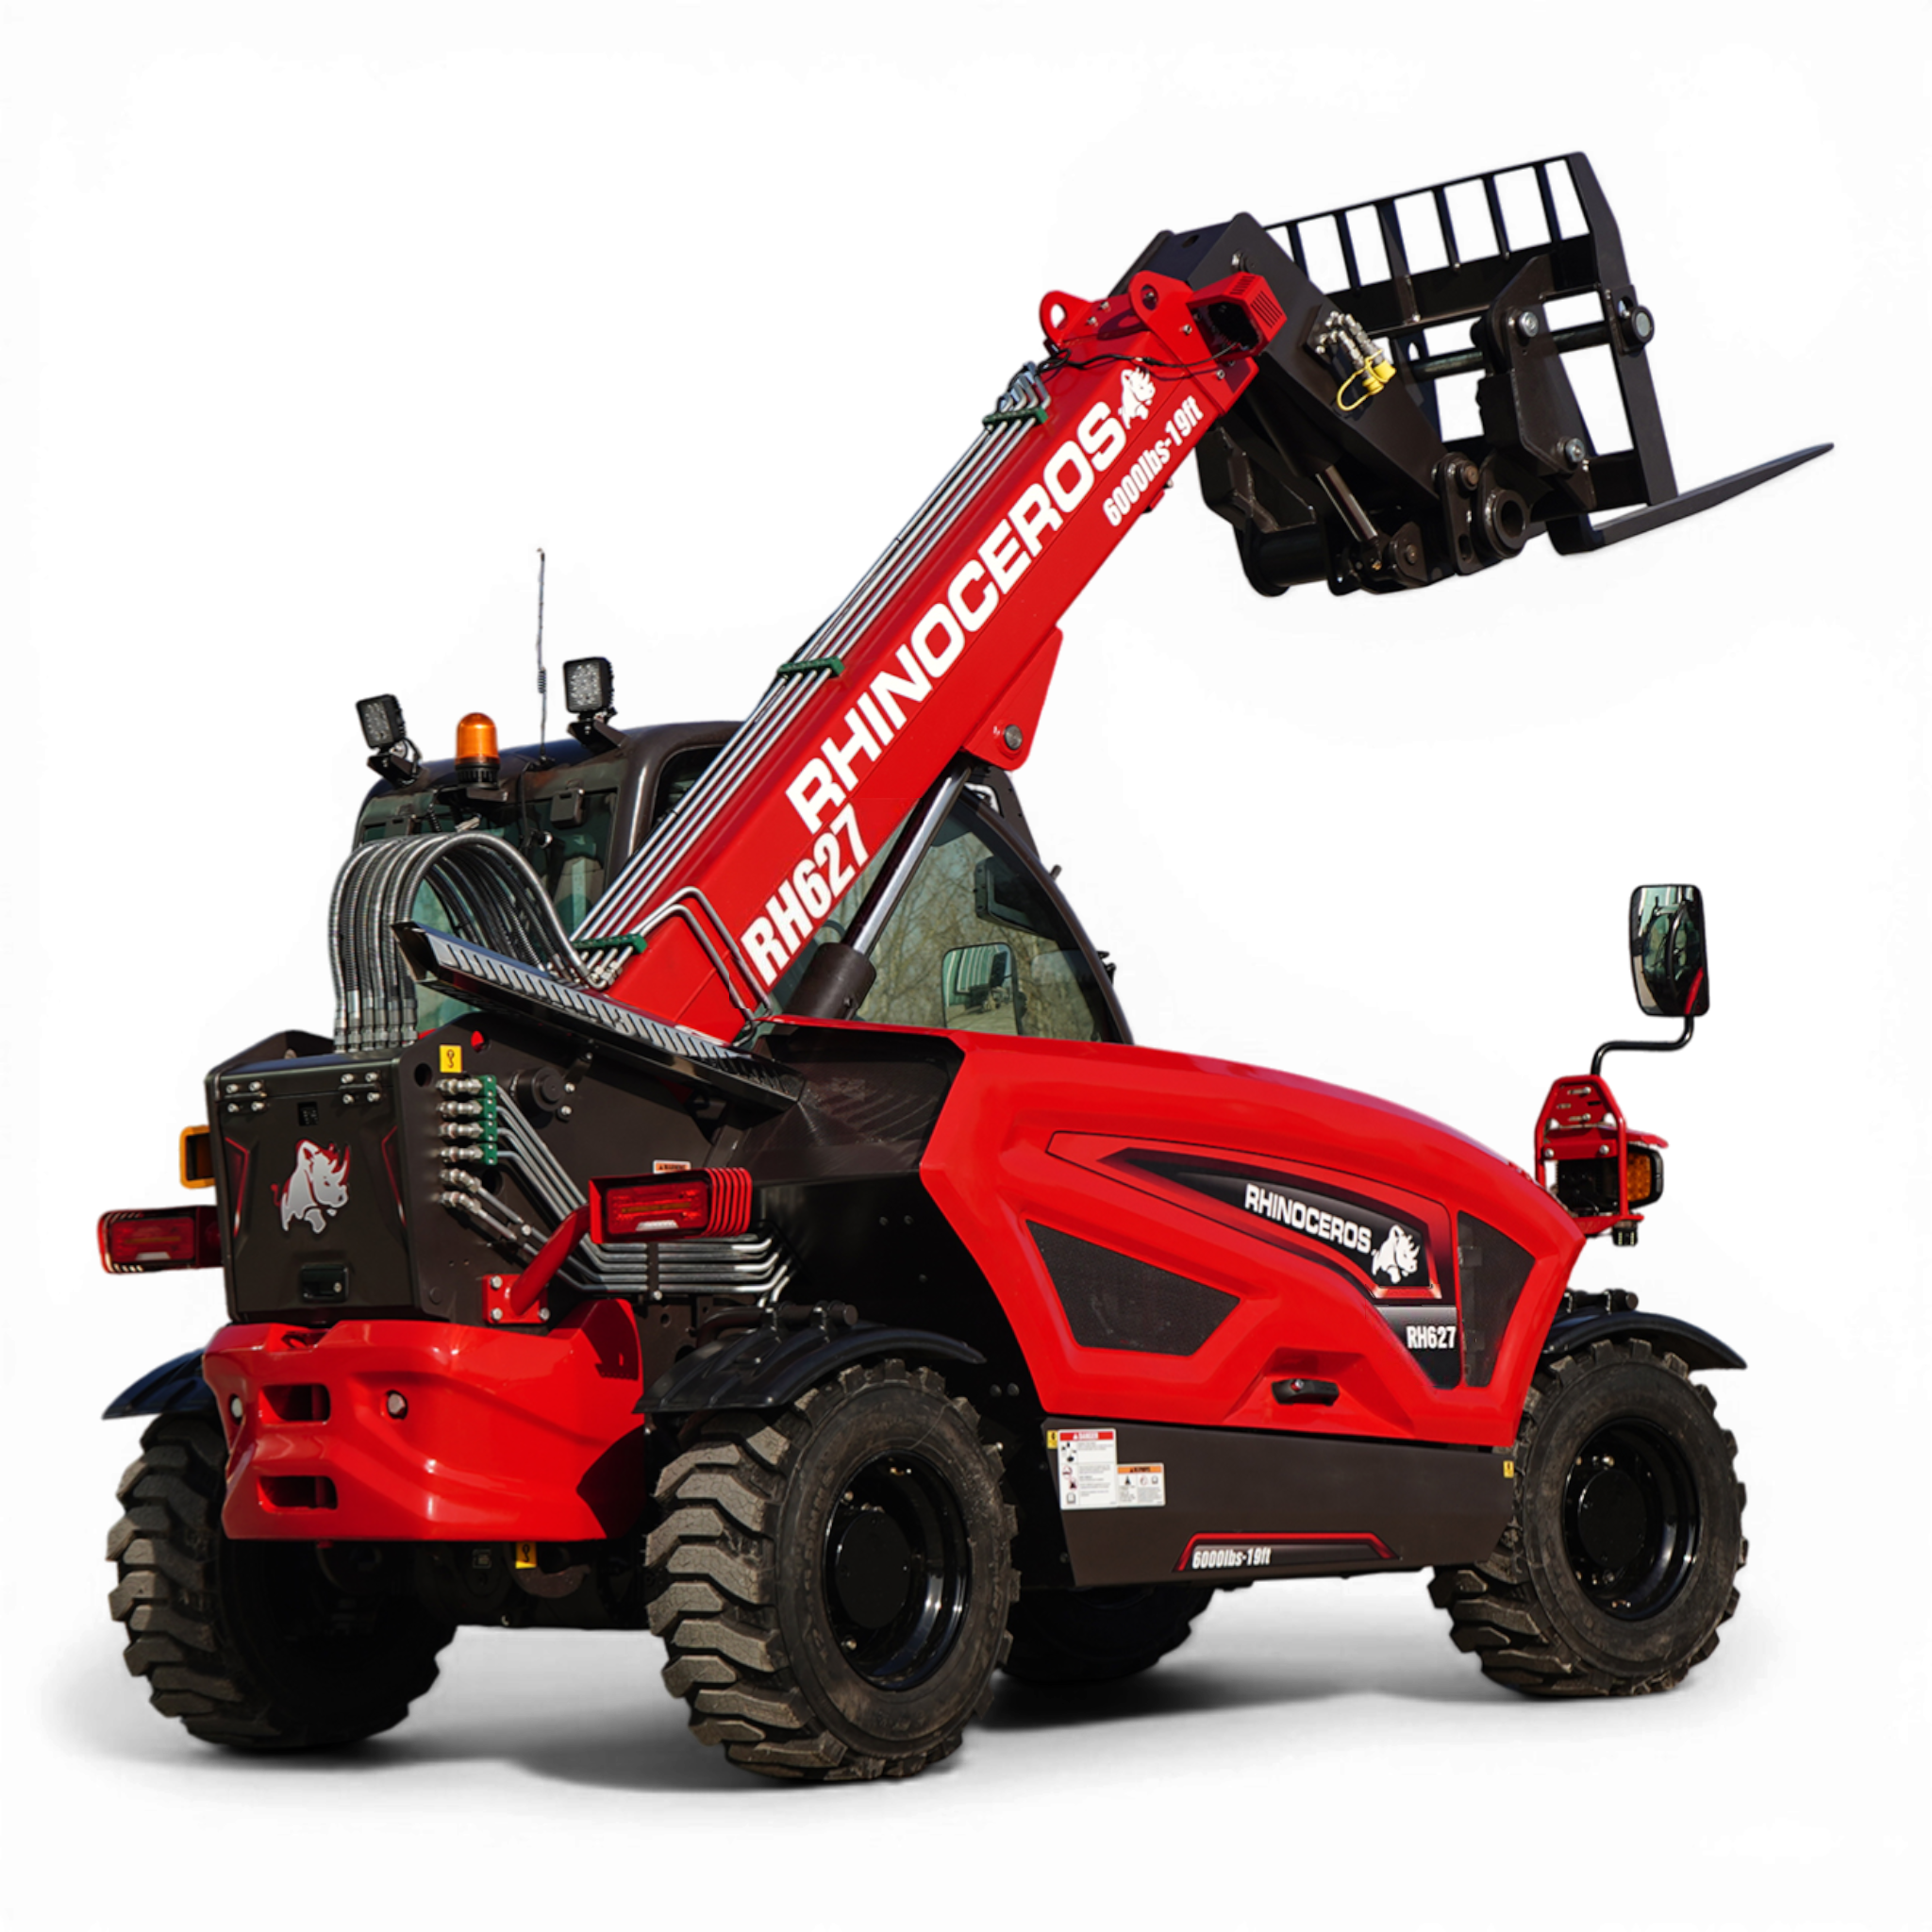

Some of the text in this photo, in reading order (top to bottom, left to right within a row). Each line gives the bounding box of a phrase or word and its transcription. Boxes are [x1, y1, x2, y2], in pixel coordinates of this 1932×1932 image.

[1102, 394, 1205, 527] 6000lbs-19ft
[785, 401, 1127, 835] RHINOCEROS
[740, 802, 870, 988] RH627
[1243, 1182, 1373, 1255] RHINOCEROS
[1406, 1325, 1457, 1349] RH627
[1191, 1547, 1272, 1570] 6000lbs-19ft
